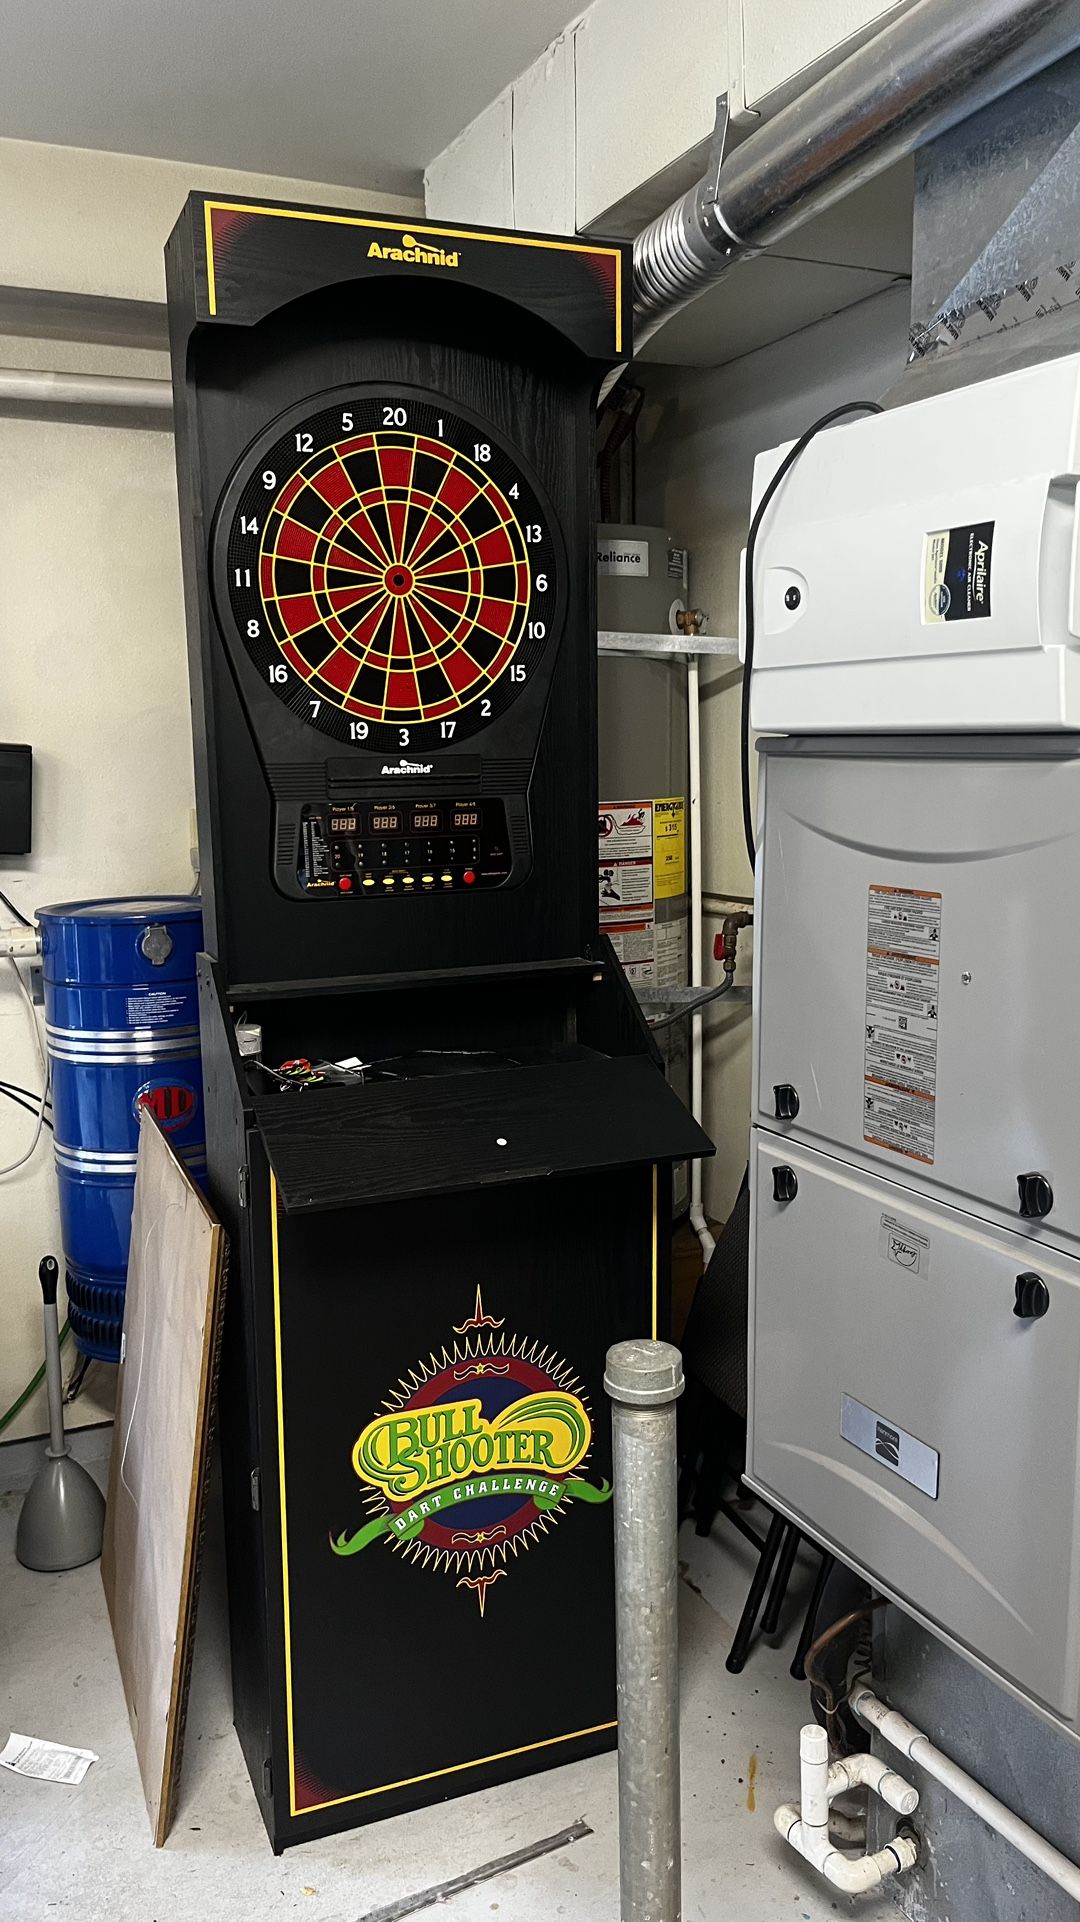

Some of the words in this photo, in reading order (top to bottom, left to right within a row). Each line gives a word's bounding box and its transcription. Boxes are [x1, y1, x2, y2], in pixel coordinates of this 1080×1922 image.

[367, 241, 460, 268] Arachnid
[341, 412, 354, 432] 5
[382, 406, 408, 427] 20
[437, 418, 445, 438] 1
[295, 432, 314, 453] 12
[473, 443, 492, 463] 18
[262, 470, 277, 491] 9
[508, 482, 520, 500] 4
[240, 515, 259, 535] 14
[525, 524, 543, 543] 13
[596, 551, 641, 563] Reliance
[967, 532, 975, 571] ELECTRONIC
[234, 568, 251, 588] 11
[974, 540, 989, 602] Aprilaire
[535, 573, 548, 593] 6
[246, 619, 260, 638] 8
[527, 621, 546, 639] 10
[268, 664, 289, 684] 16
[510, 664, 527, 682] 15
[309, 701, 322, 719] 7
[480, 698, 492, 717] 2
[349, 721, 369, 740] 19
[399, 728, 410, 747] 3
[440, 721, 457, 739] 17
[381, 764, 433, 775] Arachnid
[387, 1406, 485, 1469] BULL
[390, 1428, 556, 1494] SHOOTER
[394, 1495, 442, 1531] DART
[453, 1477, 559, 1501] CHALLENGE
